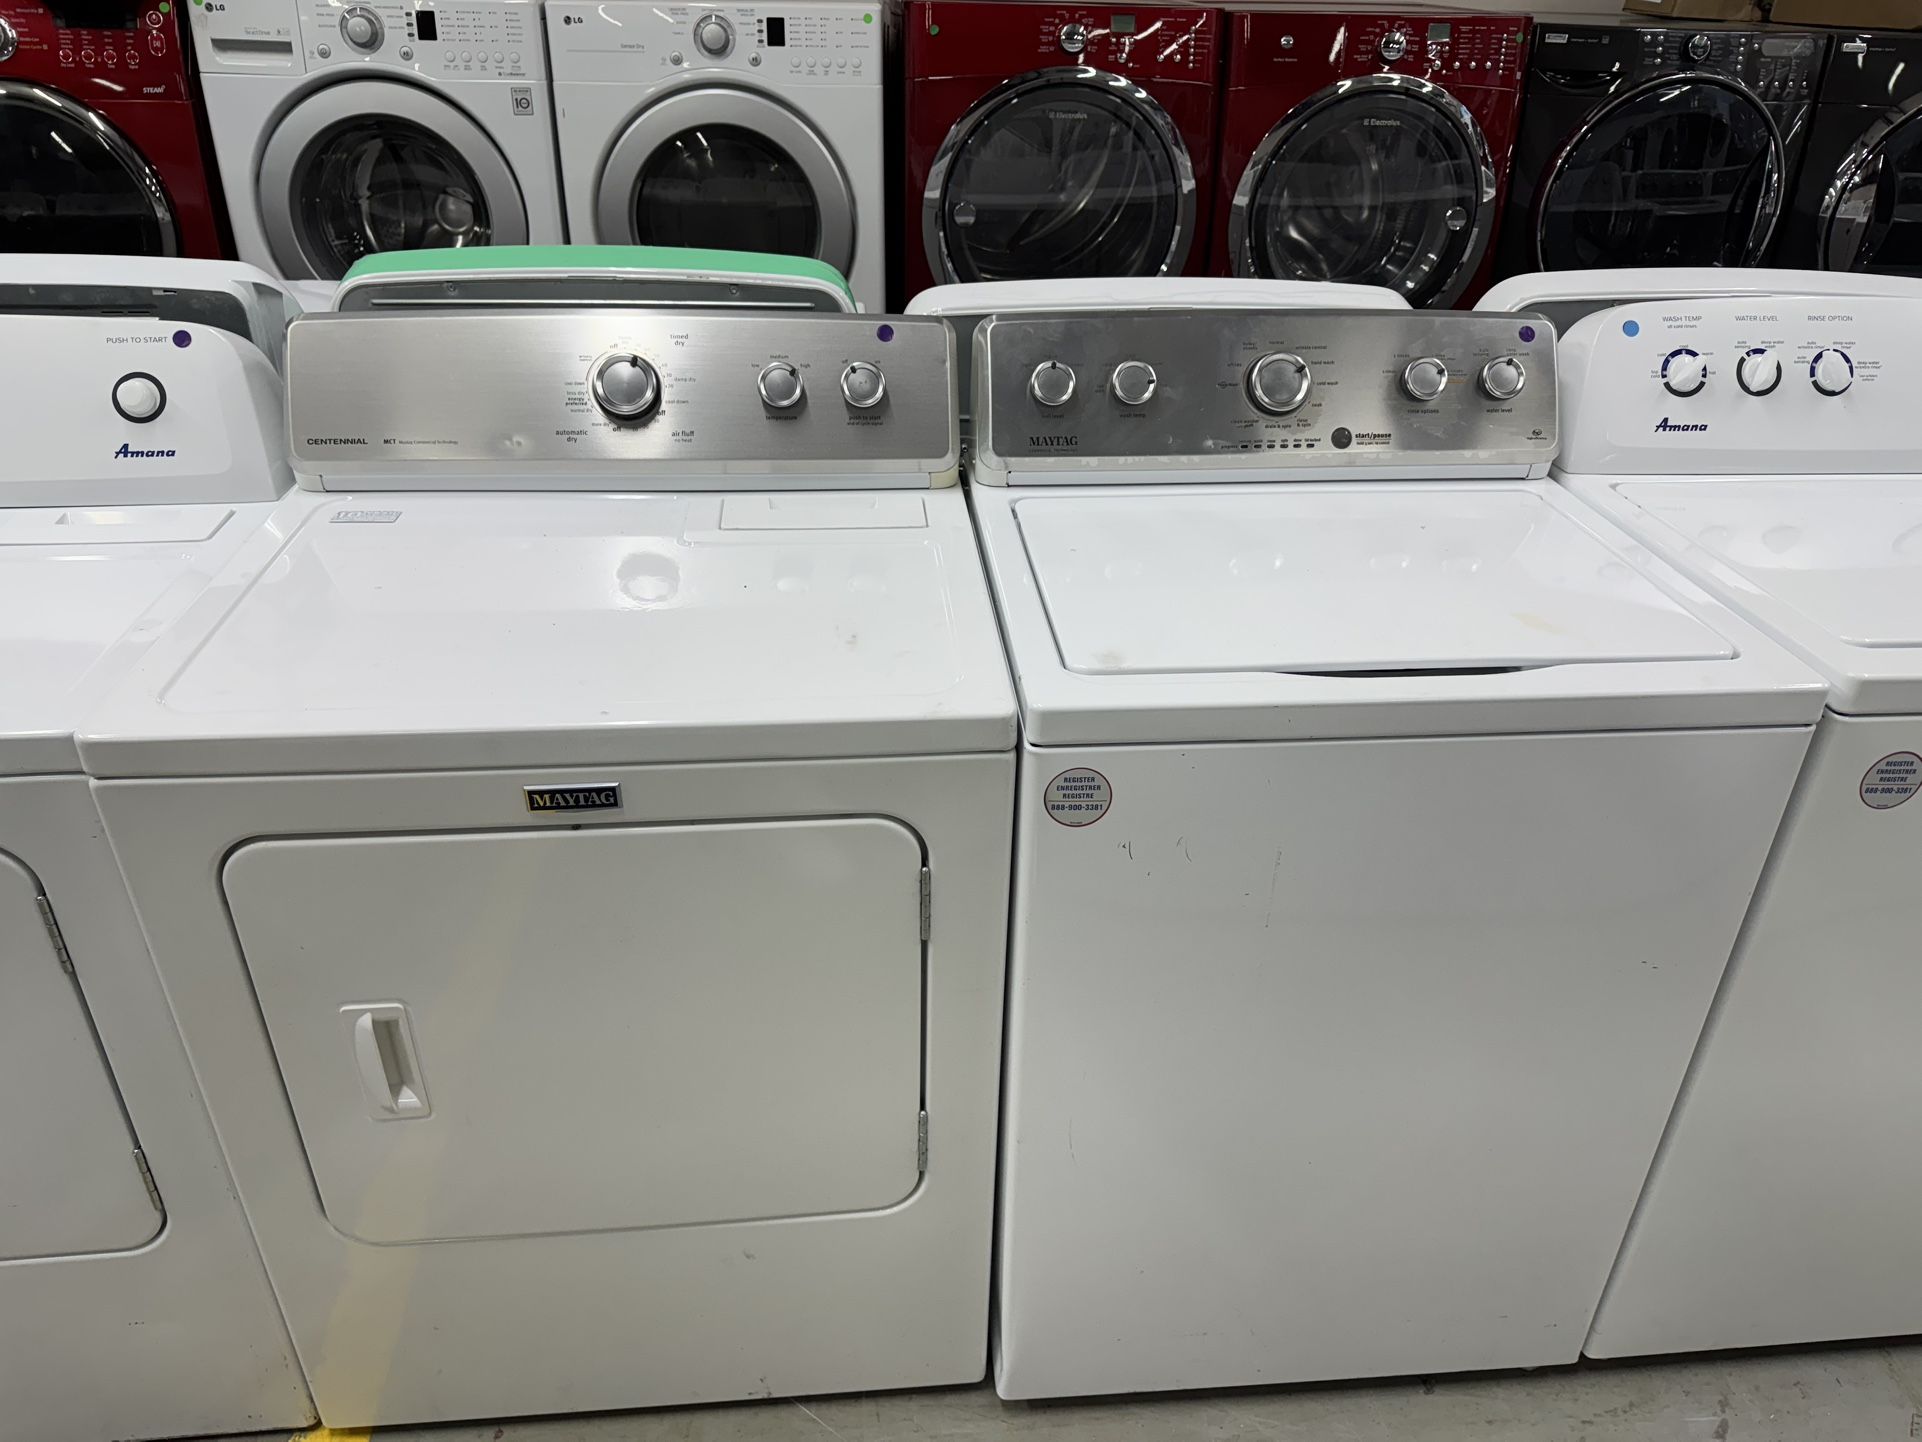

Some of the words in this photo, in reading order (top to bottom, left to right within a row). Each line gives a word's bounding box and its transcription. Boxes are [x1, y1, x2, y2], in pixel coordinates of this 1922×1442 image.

[215, 4, 226, 12] LG
[1370, 118, 1400, 126] Electrolux
[144, 336, 168, 344] START
[1654, 417, 1708, 433] Amana
[1355, 432, 1392, 440] start/pause
[306, 437, 369, 446] CENTENNIAL
[1029, 436, 1078, 447] MAYTAG
[114, 443, 176, 459] Amana
[531, 791, 615, 807] MAYTAG
